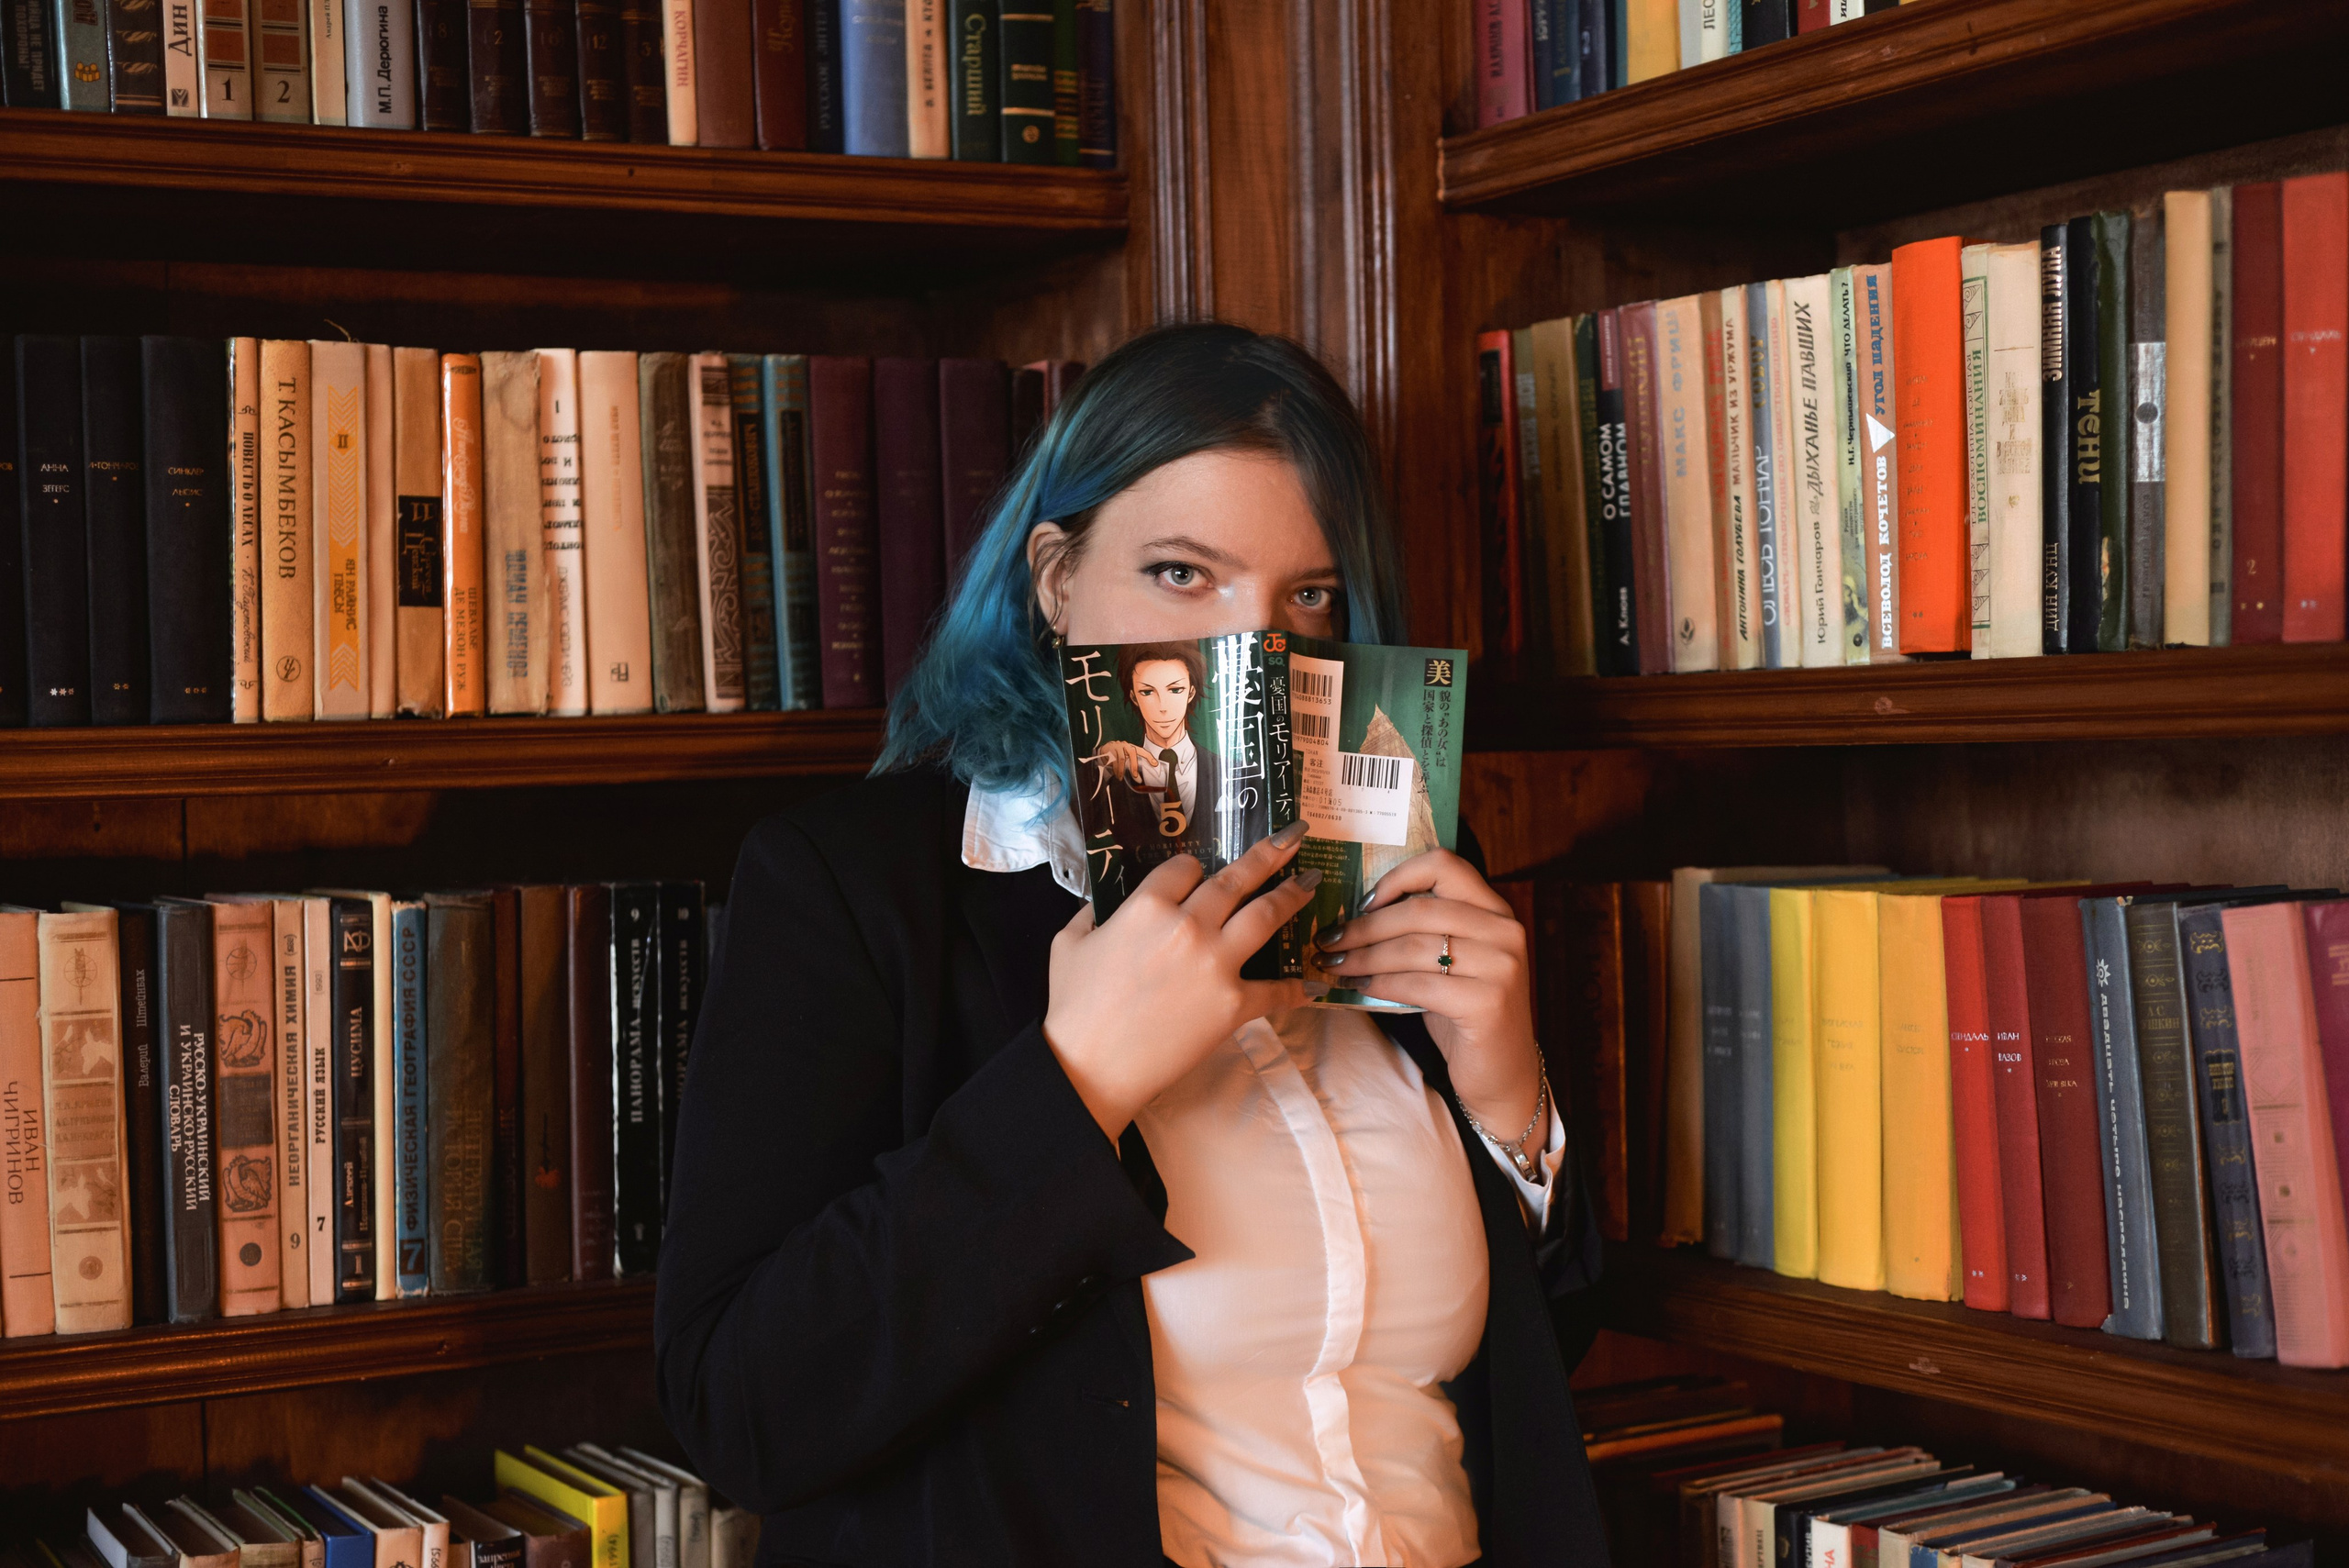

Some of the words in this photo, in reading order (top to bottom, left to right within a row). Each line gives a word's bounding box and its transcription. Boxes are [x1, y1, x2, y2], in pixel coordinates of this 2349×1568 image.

[375, 5, 394, 80] Дерюгина
[674, 10, 689, 88] КОРЧАГИН
[961, 13, 987, 117] Старший
[222, 78, 234, 101] 1
[277, 80, 291, 103] 2
[377, 81, 394, 114] М.П.
[2041, 245, 2063, 295] ЛУНА
[1665, 310, 1683, 393] ФРИШ
[1725, 317, 1737, 384] УРЖУМА
[1793, 300, 1817, 391] ПАВШИХ
[1842, 332, 1853, 357] ЧТО
[1865, 273, 1883, 365] ПАДЕНИЯ
[2042, 300, 2064, 382] ЗИМНЯЯ
[1729, 388, 1739, 408] ИЗ
[1844, 361, 1856, 445] Чернышевский
[1871, 369, 1886, 416] УГОЛ
[40, 462, 70, 473] АННА
[242, 431, 255, 490] ПОВЕСТЬ
[1598, 422, 1616, 500] САМОМ
[1673, 406, 1687, 477] МАКС
[1730, 412, 1742, 485] МАЛЬЧИК
[1801, 397, 1823, 495] ДЫХАНЬЕ
[1969, 348, 1987, 523] ВОСПОМИНАНИЯ
[2076, 388, 2101, 484] ТЕНИ
[277, 398, 296, 580] КАСЫМБЕКОВ
[1602, 503, 1617, 520] О
[1875, 455, 1890, 544] КОЧЕТОВ
[240, 503, 254, 548] ЛЕСАХ
[1732, 494, 1745, 562] ГОЛУБЕВА
[1811, 521, 1825, 594] Гончаров
[2044, 541, 2059, 585] КУНЦ
[455, 608, 466, 659] МЕЗОН
[1736, 568, 1749, 640] АНТОНИНА
[1815, 596, 1827, 644] Юрий
[1878, 552, 1893, 648] ВСЕВОЛОД
[2044, 589, 2060, 631] ДИН
[1426, 660, 1452, 686] 美
[1065, 651, 1128, 897] モリアーティ
[1268, 675, 1294, 823] 憂国のモリアーティ
[1159, 800, 1188, 838] 5
[401, 927, 416, 982] СССР
[630, 939, 643, 1009] искусств
[136, 968, 148, 1029] Штейнбах
[284, 966, 298, 1025] ХИМИЯ
[180, 1024, 191, 1037] И
[350, 1006, 364, 1078] ЦУСИМА
[402, 987, 417, 1098] ГЕОГРАФИЯ
[1997, 1031, 2021, 1041] ИВАН
[137, 1043, 151, 1088] Валерий
[314, 1046, 326, 1084] ЯЗЫК
[629, 1018, 644, 1123] ПАНОРАМА
[3, 1080, 24, 1206] ЧИГРИНОВ
[23, 1108, 40, 1173] ИВАН
[169, 1084, 191, 1152] СЛОВАРЬ
[180, 1040, 197, 1211] УКРАИНСКО-РУССКИЙ
[194, 1032, 211, 1201] РУССКО-УКРАИНСКИЙ
[285, 1032, 301, 1187] НЕОРГАНИЧЕСКАЯ
[313, 1088, 326, 1145] РУССКИЙ
[404, 1106, 419, 1231] ФИЗИЧЕСКАЯ
[316, 1216, 327, 1233] 7
[403, 1241, 423, 1270] 7
